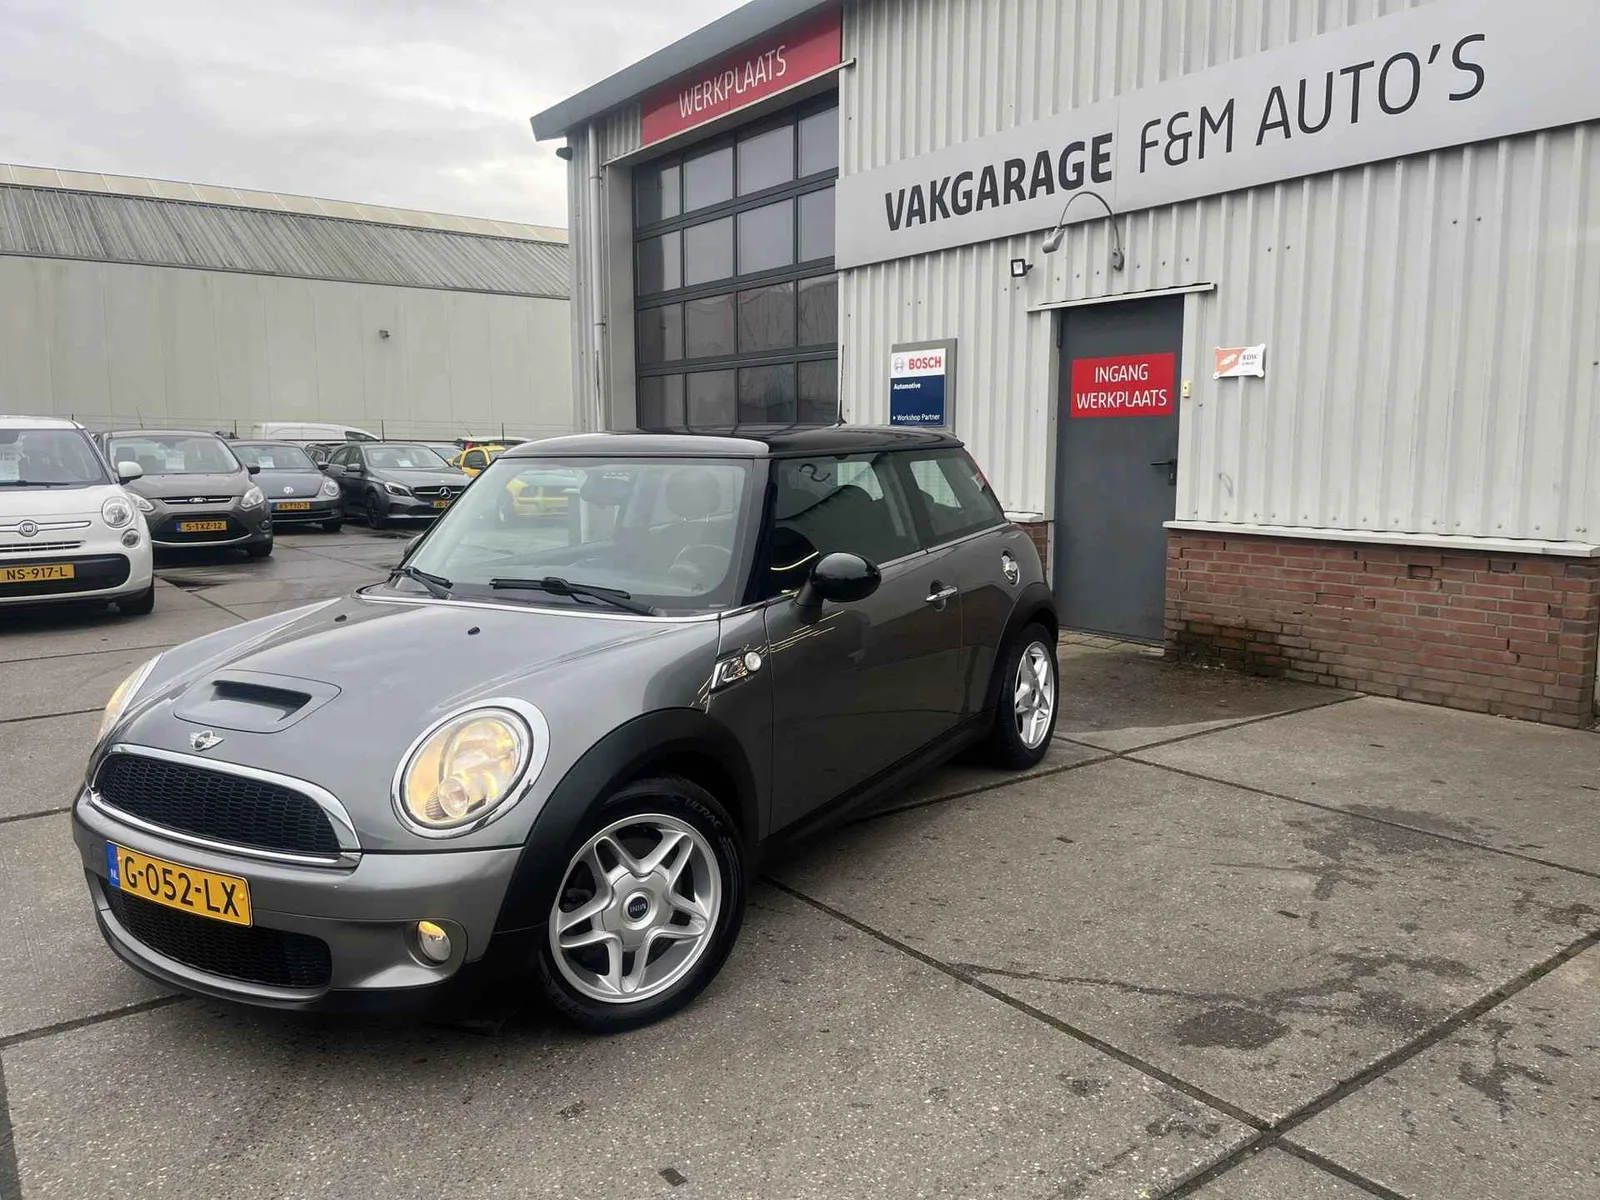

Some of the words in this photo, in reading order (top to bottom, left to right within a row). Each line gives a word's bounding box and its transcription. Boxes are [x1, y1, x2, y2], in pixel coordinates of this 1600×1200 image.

[679, 45, 787, 118] WERKPLAATS
[885, 133, 1113, 232] VAKGARAGE
[1139, 97, 1236, 174] F&M
[1256, 33, 1486, 147] AUTO'S
[908, 356, 942, 370] BOSCH
[1095, 363, 1149, 383] INGANG
[893, 382, 921, 390] Automotive
[1076, 389, 1167, 409] WERKPLAATS
[897, 414, 921, 422] Workshop
[921, 413, 941, 421] Partner
[6, 566, 68, 581] NS-917-L
[124, 856, 240, 917] G-052-LX
